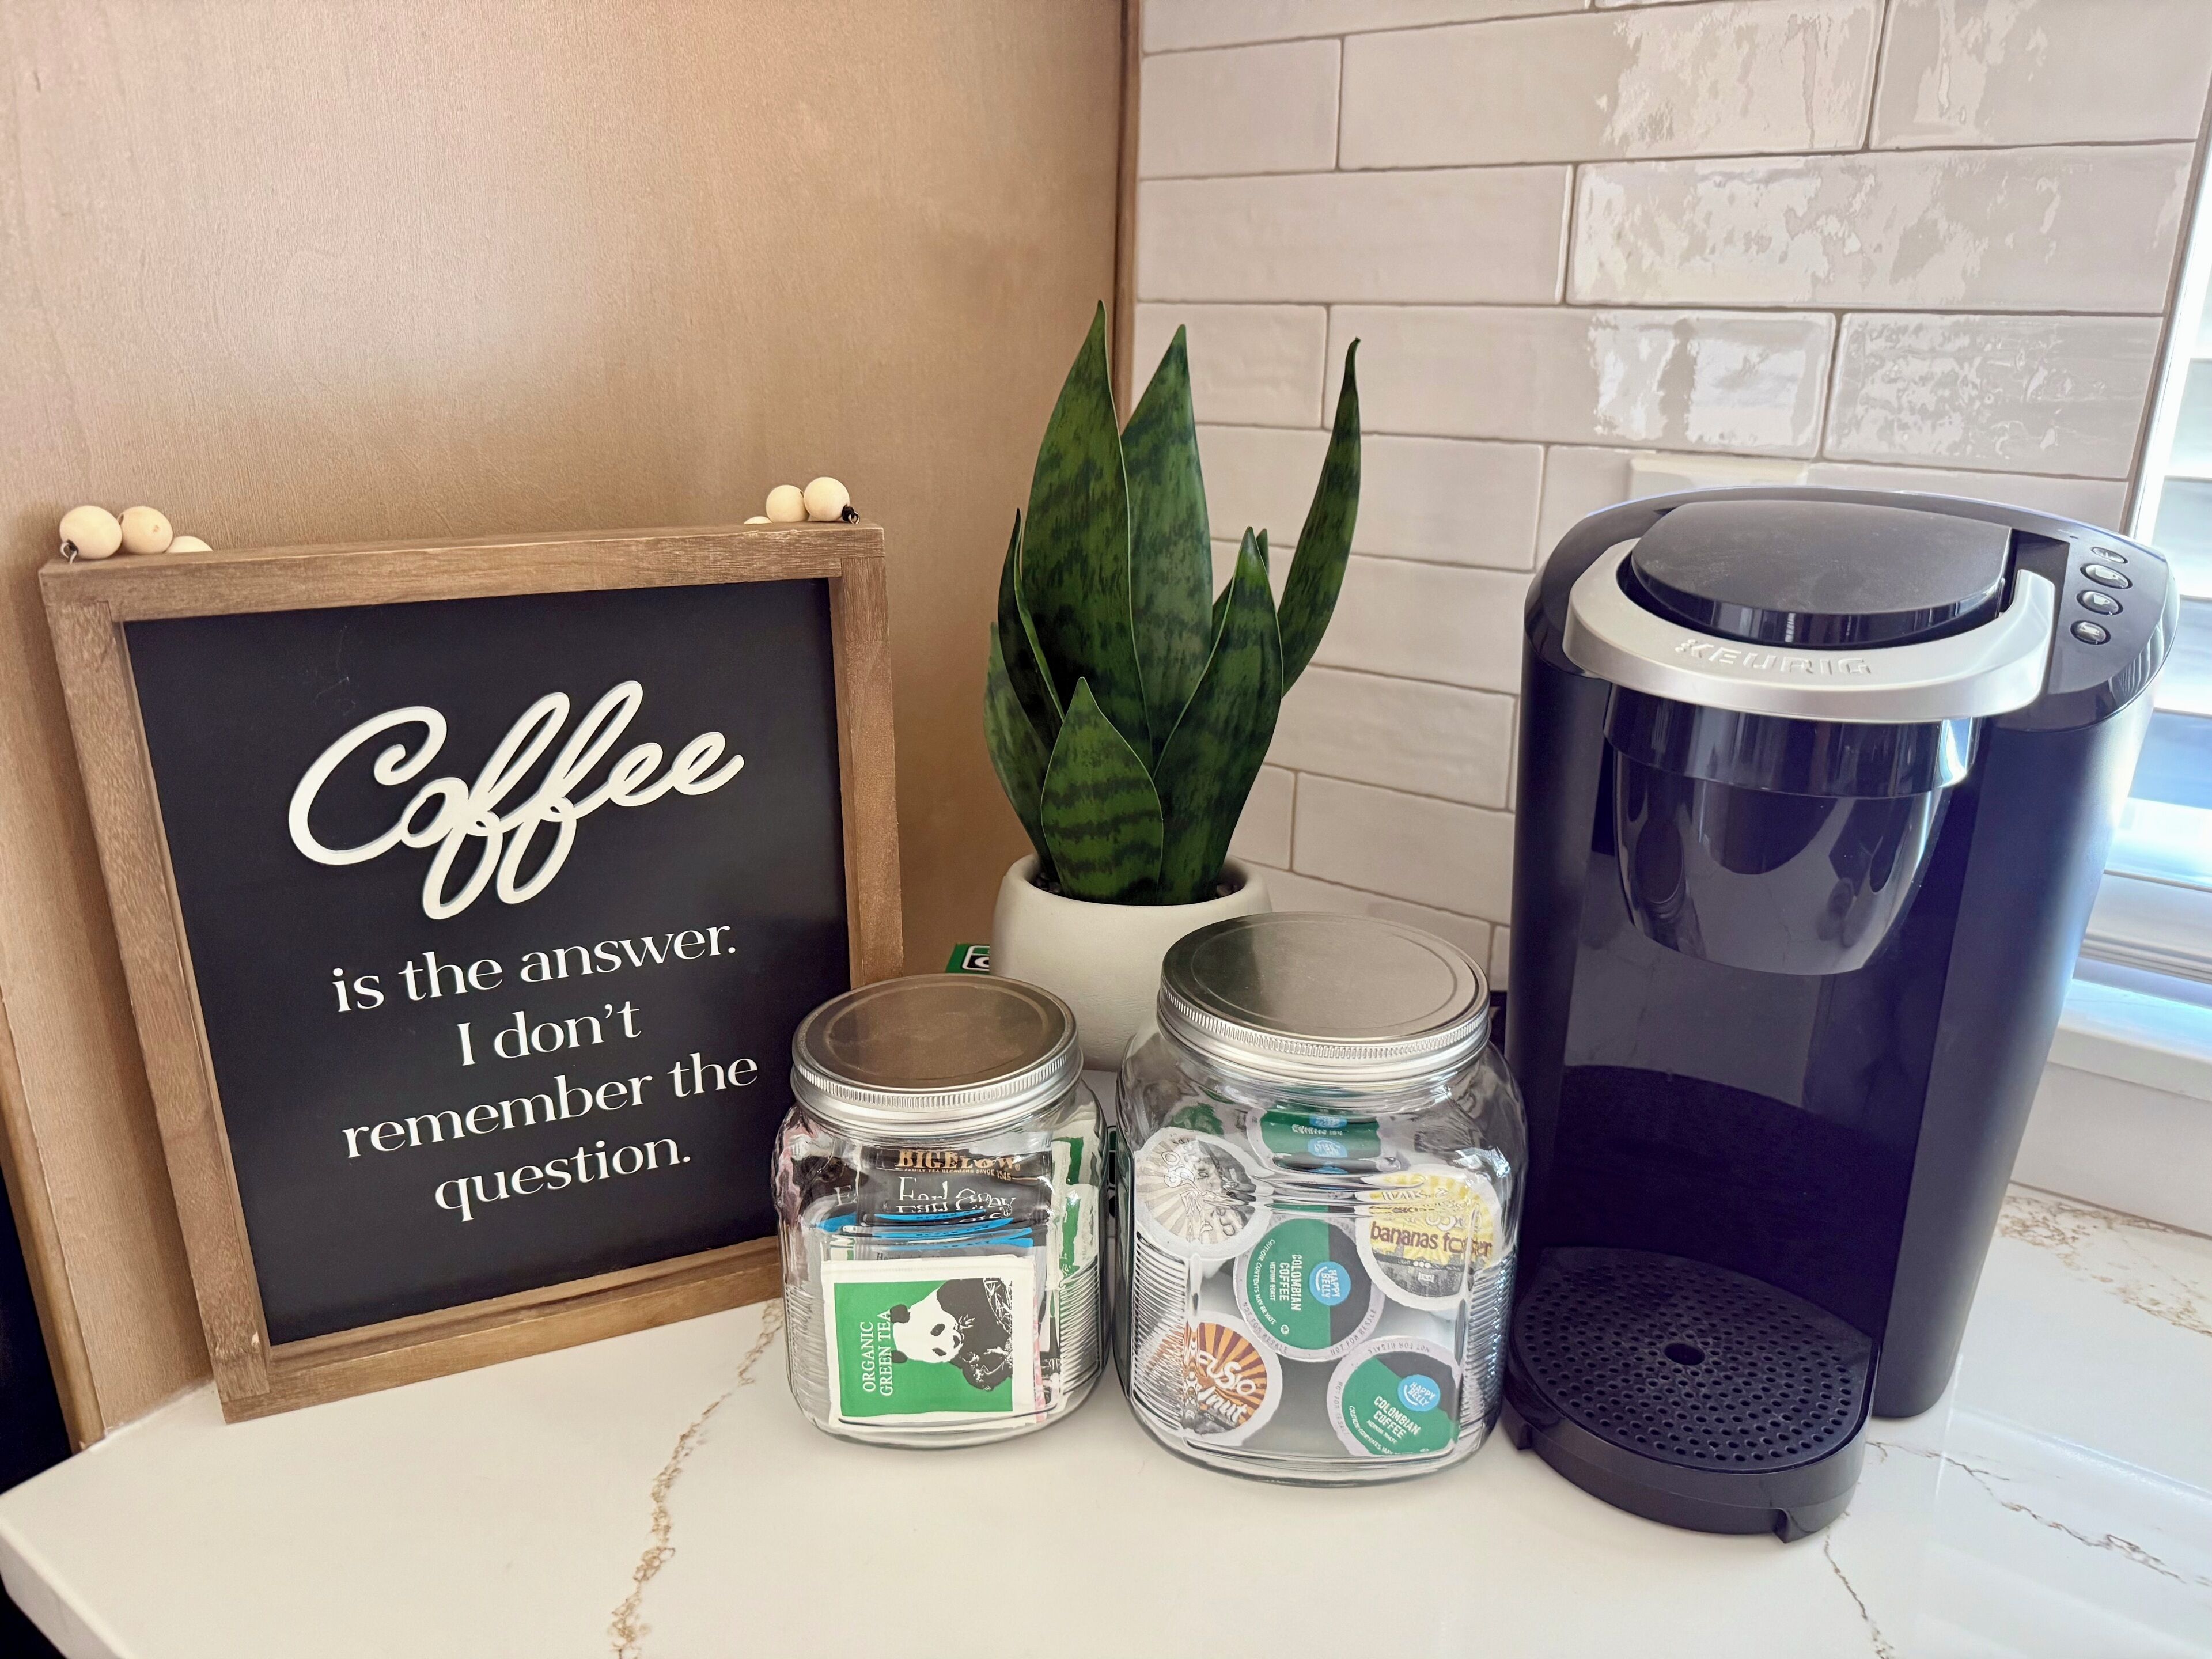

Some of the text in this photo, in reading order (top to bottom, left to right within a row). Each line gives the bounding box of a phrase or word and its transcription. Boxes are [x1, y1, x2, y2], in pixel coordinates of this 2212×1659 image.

[1690, 642, 1871, 675] KEURIG
[289, 681, 745, 920] Coffee
[332, 925, 736, 1012] is the answer.
[456, 1022, 476, 1066] I
[342, 1052, 758, 1159] remember the
[435, 1139, 691, 1222] question.
[976, 1168, 995, 1177] SINCE
[1371, 1221, 1438, 1250] bananas
[1279, 1262, 1290, 1301] COFFEE
[1291, 1254, 1302, 1312] COLOMBIAN
[1321, 1272, 1332, 1299] BELLY
[1328, 1268, 1342, 1298] HAPPY
[859, 1321, 876, 1393] ORGANIC
[877, 1308, 893, 1397] GREEN TEA
[1330, 1343, 1344, 1355] NOT
[1346, 1334, 1359, 1349] FOR
[1407, 1388, 1430, 1407] BELLY
[1410, 1381, 1436, 1400] HAPPY
[1373, 1395, 1422, 1436] COLOMBIAN
[1373, 1410, 1407, 1440] COFFEE
